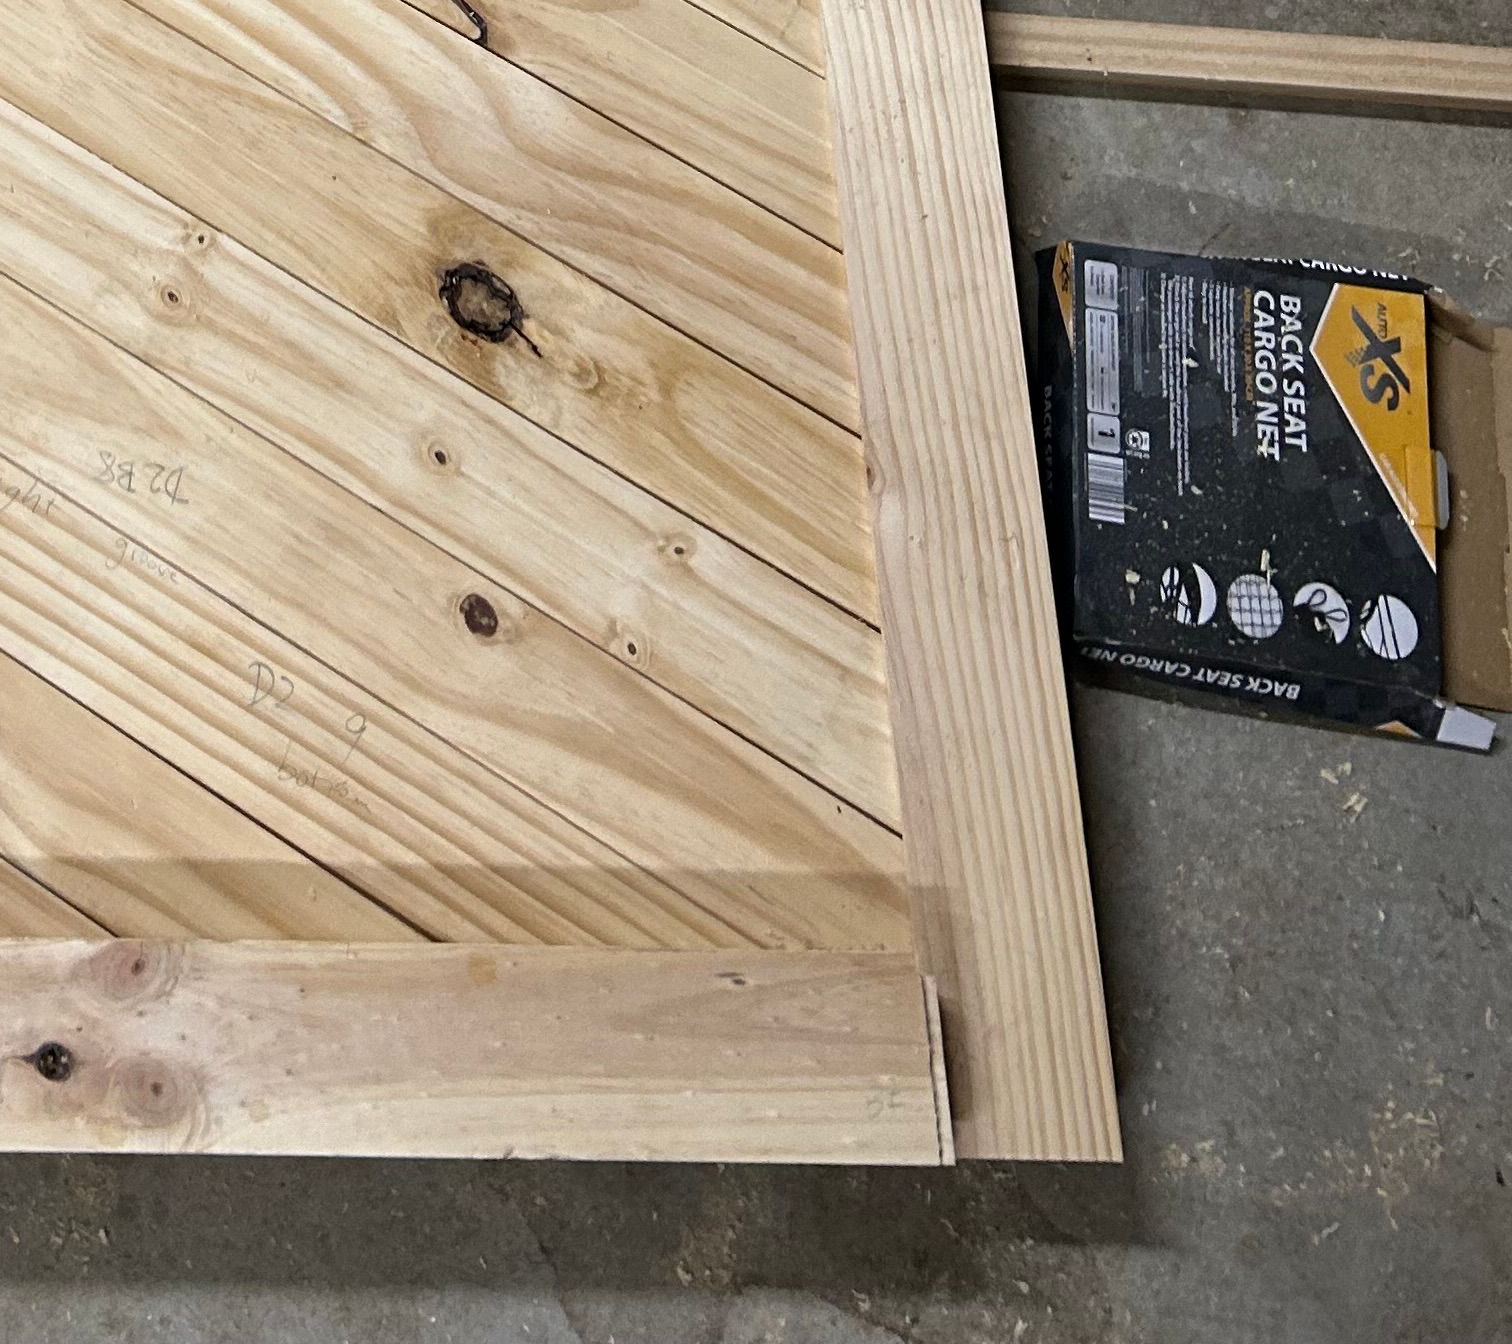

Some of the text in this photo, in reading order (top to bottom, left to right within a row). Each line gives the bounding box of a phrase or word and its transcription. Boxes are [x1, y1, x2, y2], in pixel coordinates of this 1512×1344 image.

[1377, 302, 1389, 340] AUTO
[1253, 290, 1278, 395] CARGO
[1351, 304, 1412, 412] XS
[1280, 293, 1308, 453] BACK SEAT
[1098, 427, 1116, 438] 1
[1256, 400, 1280, 462] NET
[1120, 655, 1191, 678] CARGO
[1192, 667, 1246, 689] SEAT
[1246, 678, 1303, 702] BACK
